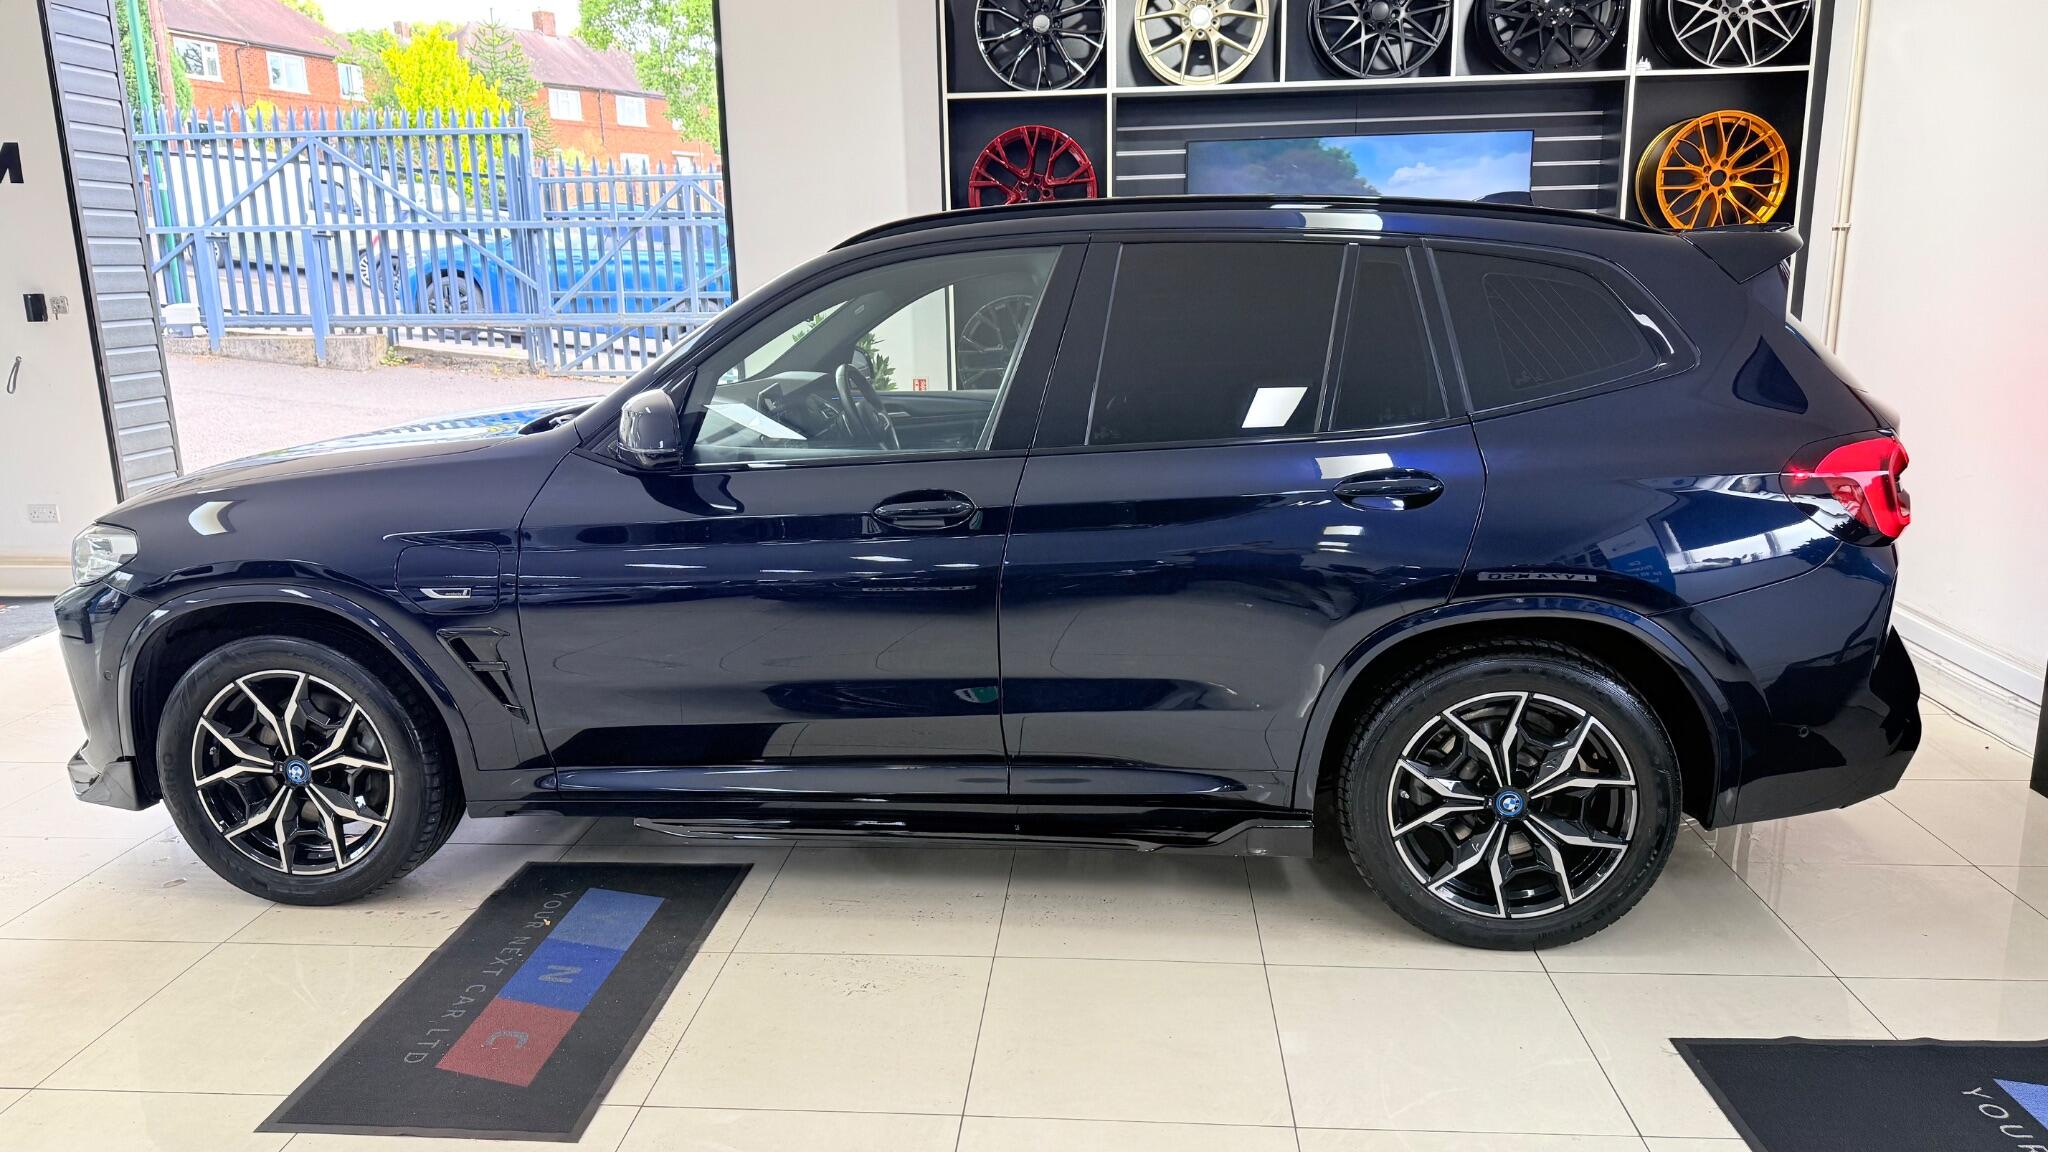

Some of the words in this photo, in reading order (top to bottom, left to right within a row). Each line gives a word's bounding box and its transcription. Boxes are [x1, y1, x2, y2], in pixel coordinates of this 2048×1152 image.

[525, 890, 574, 930] YOUR
[482, 935, 532, 978] NEXT
[537, 963, 583, 984] N
[440, 983, 487, 1019] CAR
[403, 1027, 450, 1065] LTD
[484, 1029, 530, 1049] C
